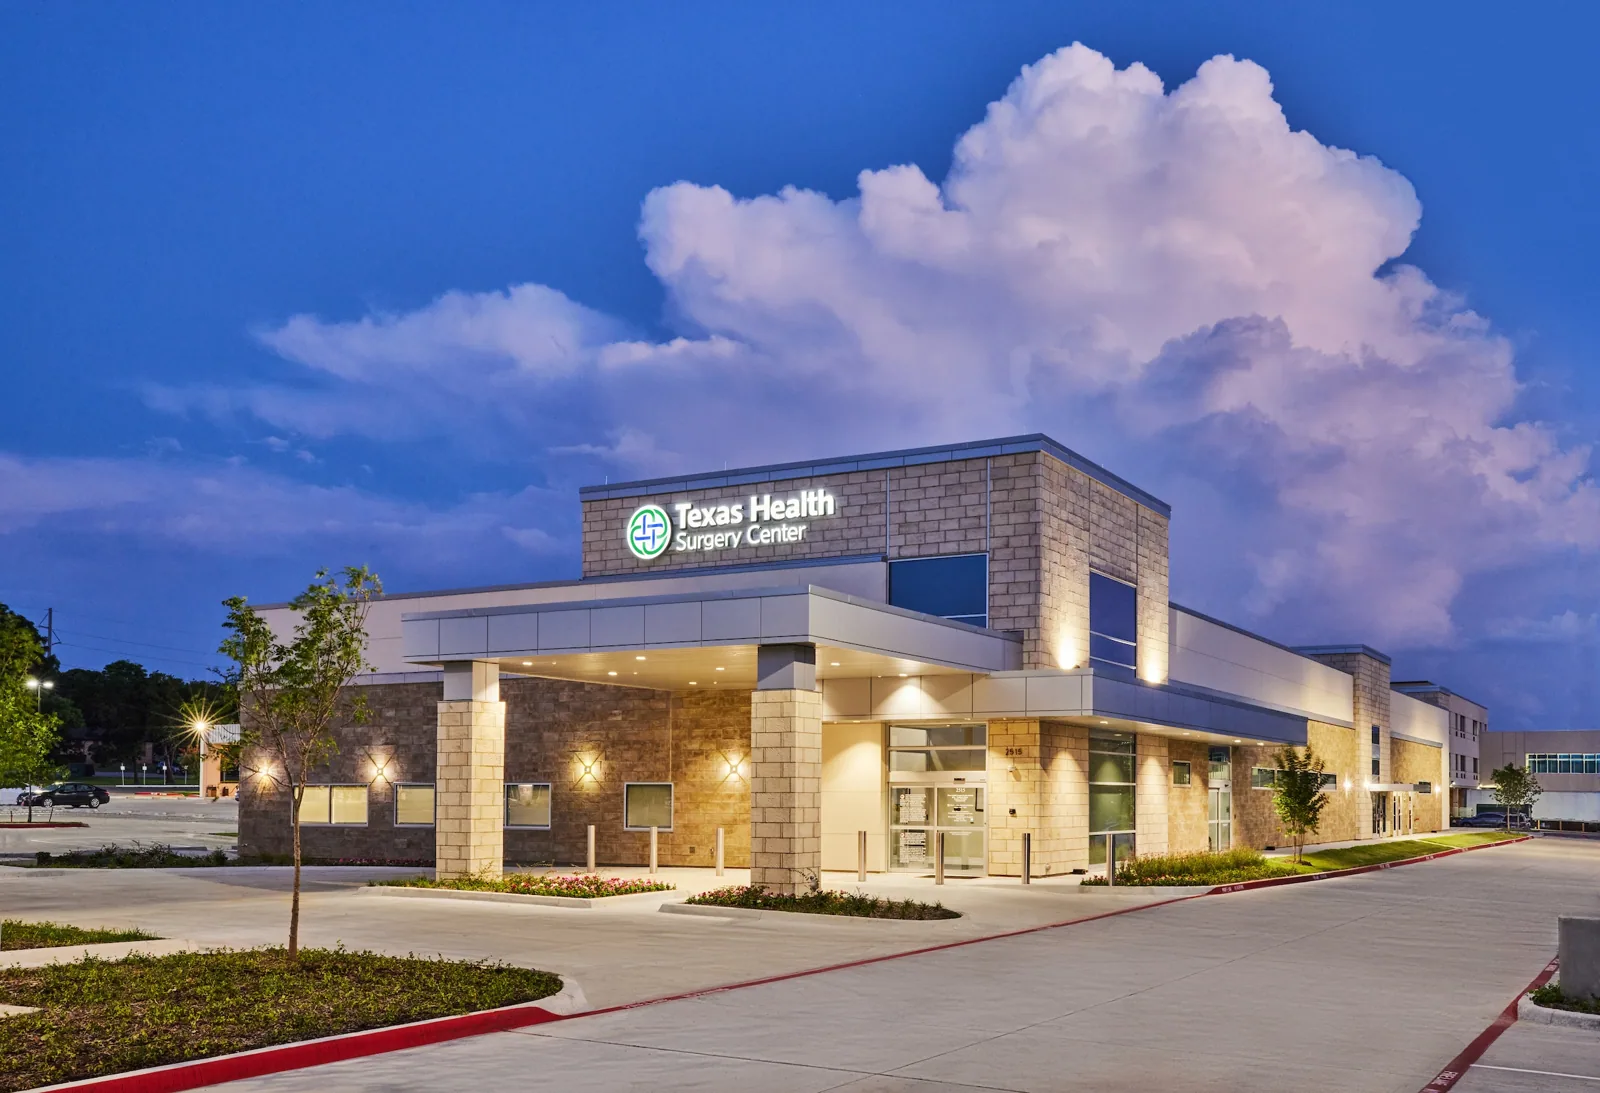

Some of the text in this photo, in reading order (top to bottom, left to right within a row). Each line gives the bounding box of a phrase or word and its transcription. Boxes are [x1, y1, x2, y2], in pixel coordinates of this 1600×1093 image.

[675, 489, 835, 529] Texas Health
[675, 524, 806, 551] Surgery Center
[1005, 747, 1022, 756] 2515
